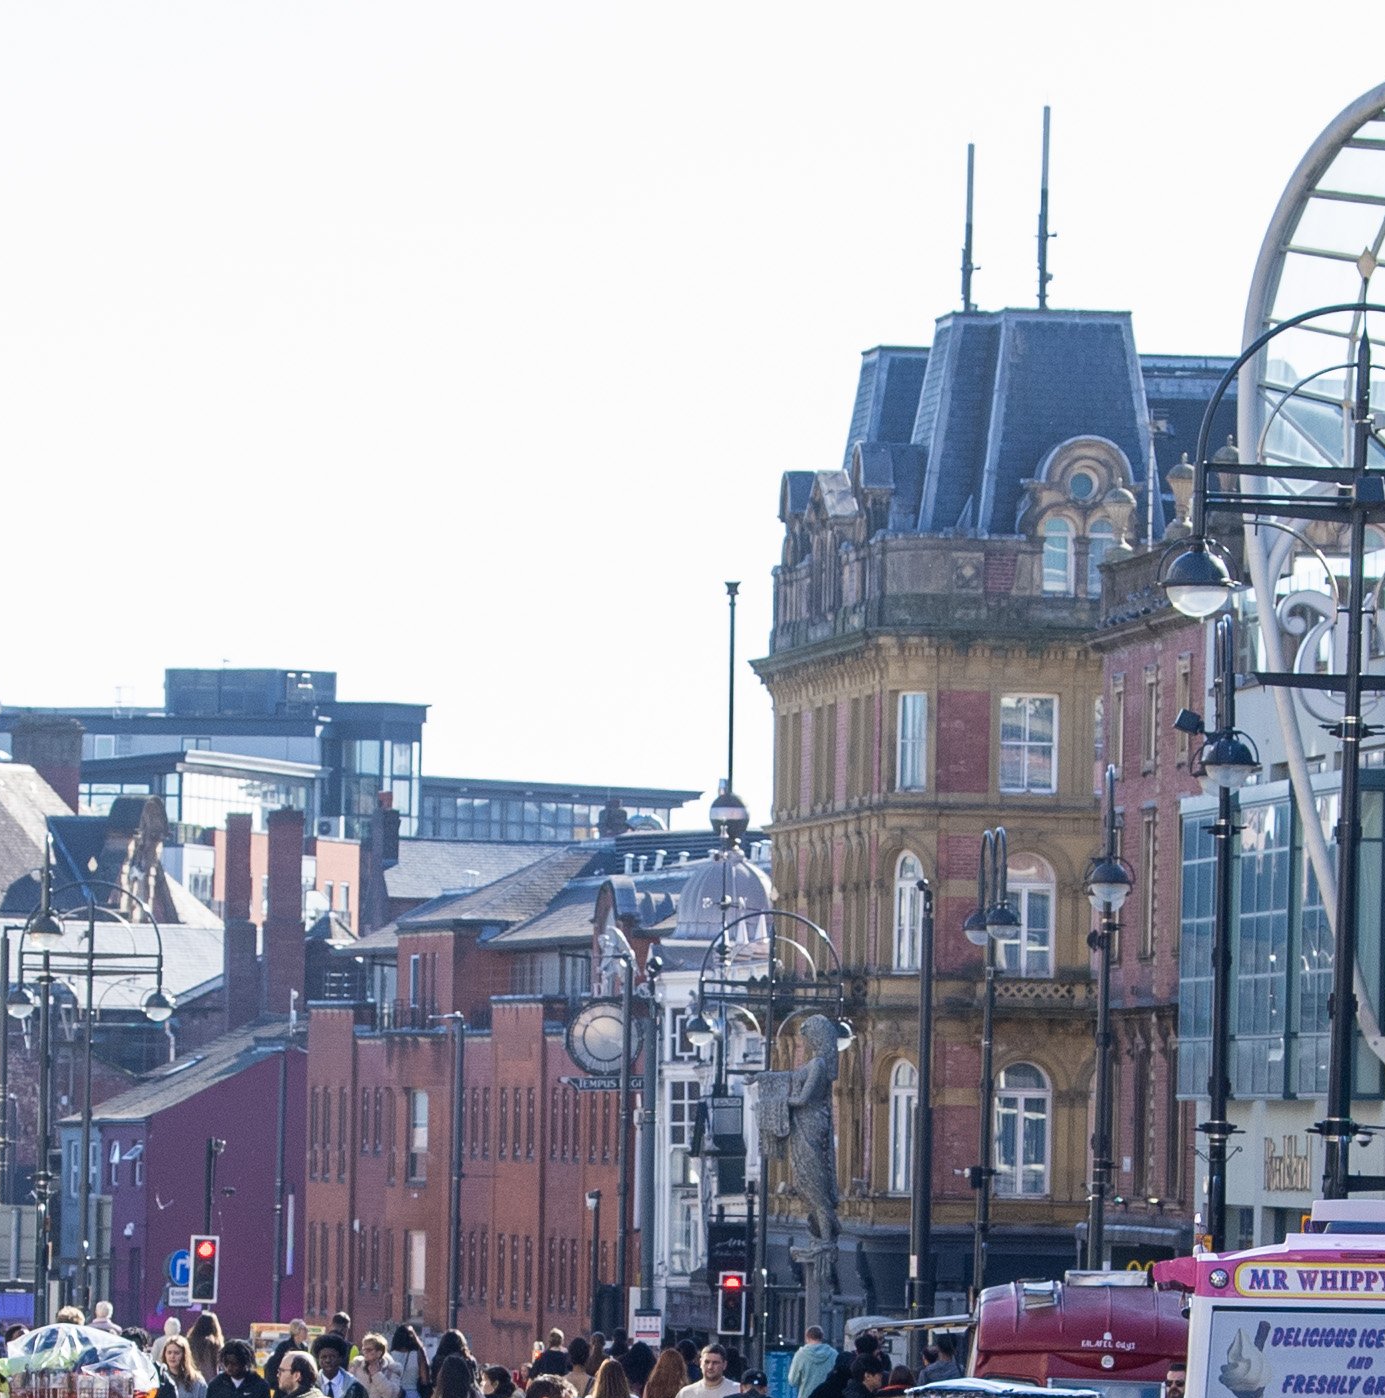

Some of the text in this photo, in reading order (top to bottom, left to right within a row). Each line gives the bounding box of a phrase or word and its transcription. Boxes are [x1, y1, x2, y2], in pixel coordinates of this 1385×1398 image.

[1249, 1269, 1289, 1290] MR
[1271, 1327, 1356, 1349] DELICIOUS
[1359, 1329, 1385, 1348] ICE
[1347, 1356, 1373, 1370] AND
[1282, 1374, 1360, 1395] FRESHLY
